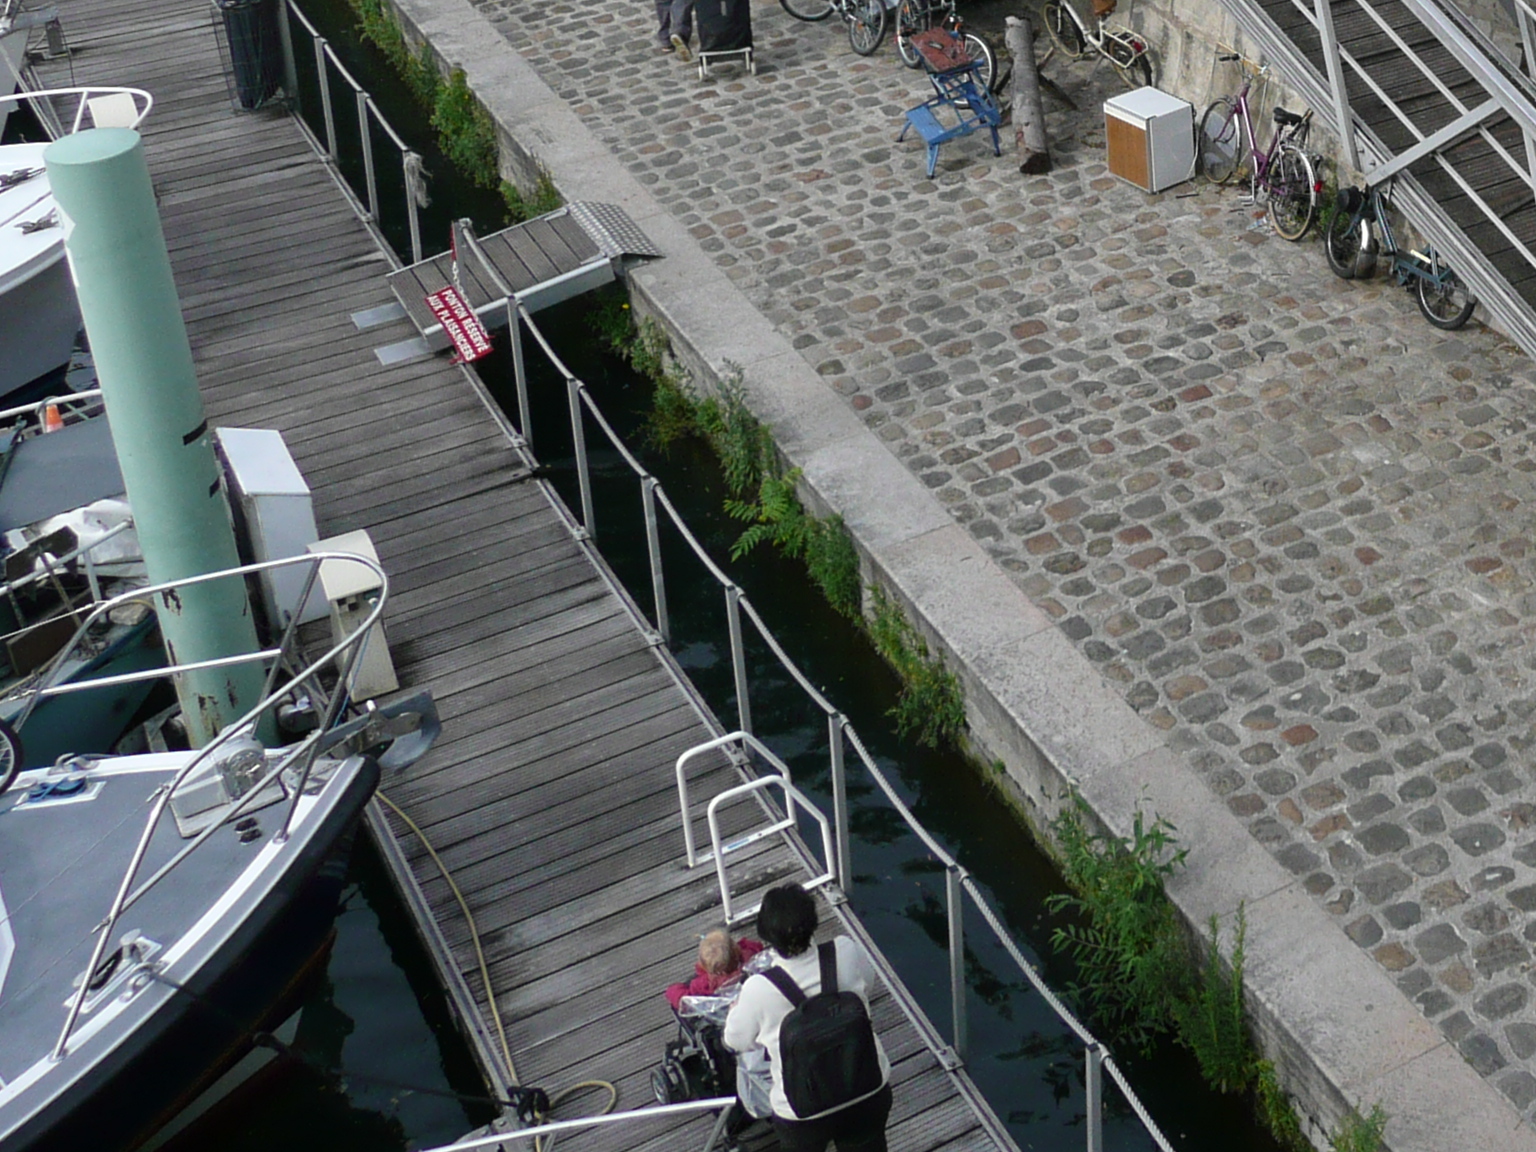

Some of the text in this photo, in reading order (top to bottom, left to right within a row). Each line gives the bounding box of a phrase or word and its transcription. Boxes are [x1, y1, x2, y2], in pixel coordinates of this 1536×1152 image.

[441, 289, 469, 319] PONTON
[428, 295, 477, 362] AUX PLAISANCIERS
